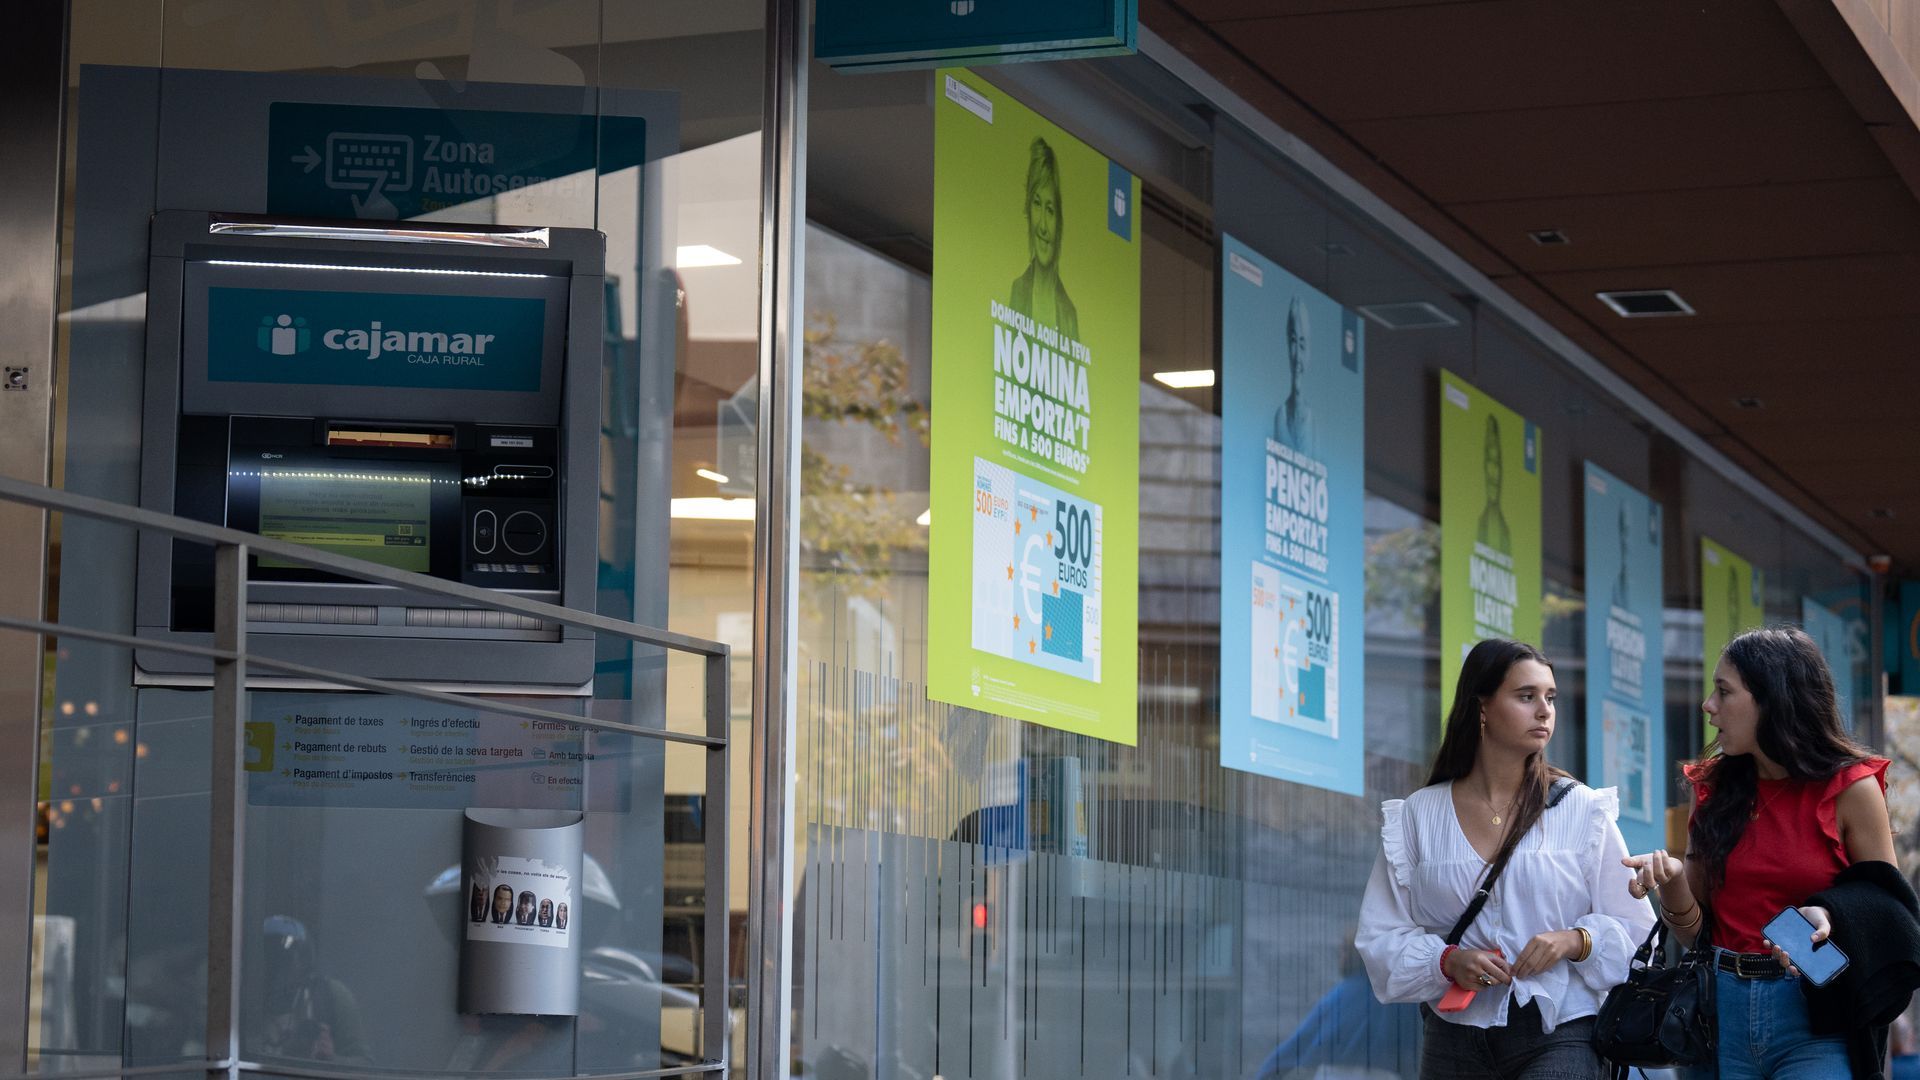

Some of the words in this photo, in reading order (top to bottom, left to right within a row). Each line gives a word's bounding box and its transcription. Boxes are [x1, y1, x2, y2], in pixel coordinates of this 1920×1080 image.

[423, 135, 494, 164] Zona
[322, 320, 495, 360] cajamar
[991, 299, 1036, 338] DOMICILIA
[1037, 323, 1059, 349] AQUÍ
[1059, 334, 1070, 355] LA
[1071, 339, 1091, 364] TEVA
[407, 354, 439, 364] CAJA
[443, 355, 485, 366] RURAL
[994, 324, 1090, 414] NÒMINA
[995, 375, 1090, 451] EMPORTA'T
[994, 415, 1018, 445] FINS
[1020, 427, 1028, 450] A
[1030, 431, 1052, 460] 500
[976, 489, 993, 517] 500
[1054, 498, 1092, 569] 500
[1058, 562, 1088, 589] EUROS
[1305, 590, 1332, 645] 500
[1308, 641, 1329, 662] EUROS
[295, 714, 342, 727] Pagament
[344, 716, 356, 726] de
[359, 716, 384, 727] taxes
[411, 717, 439, 729] Ingrés
[442, 718, 480, 729] d'efectiu
[532, 720, 566, 731] Formes
[294, 741, 341, 753] Pagament
[343, 743, 355, 753] de
[357, 743, 387, 753] rebuts
[410, 744, 439, 755] Gestió
[441, 745, 453, 755] de
[455, 745, 464, 755] la
[466, 747, 487, 756] seva
[490, 747, 523, 758] targeta
[549, 751, 566, 760] Amb
[293, 768, 340, 780] Pagament
[342, 769, 393, 781] d'impostos
[409, 771, 476, 783] Transferències
[548, 776, 557, 785] En
